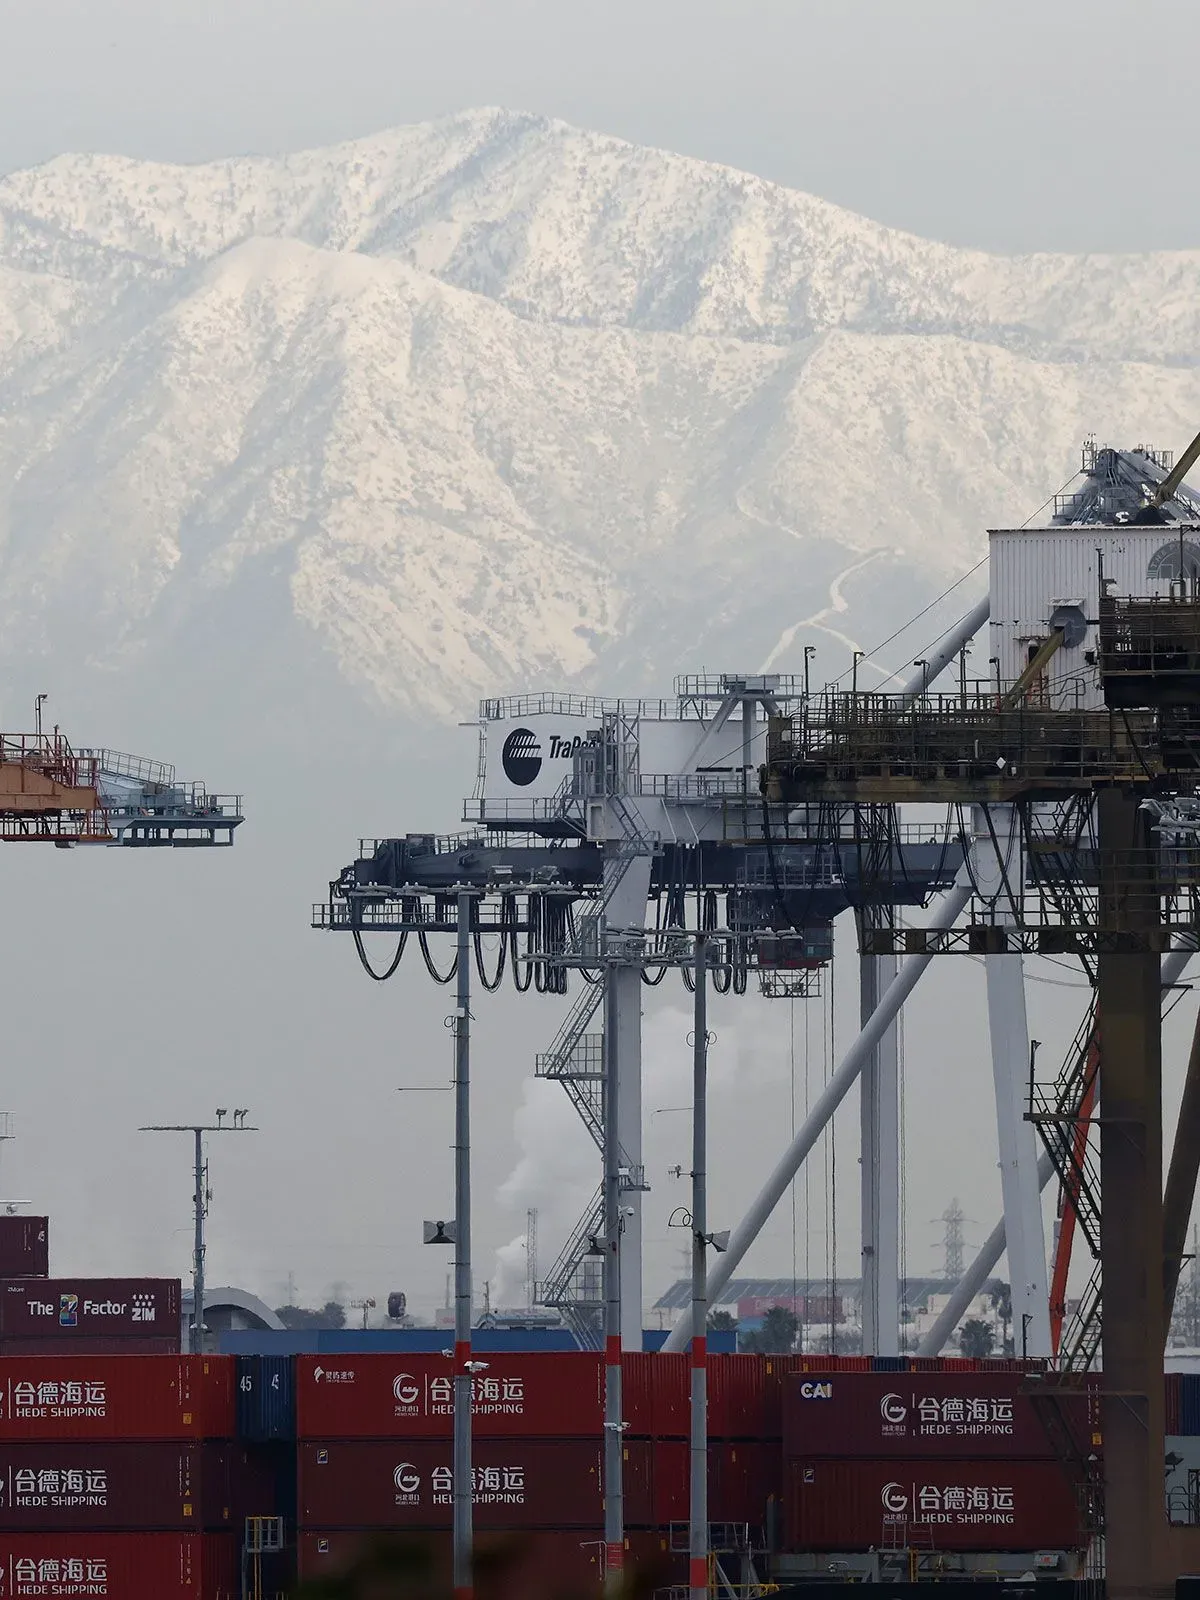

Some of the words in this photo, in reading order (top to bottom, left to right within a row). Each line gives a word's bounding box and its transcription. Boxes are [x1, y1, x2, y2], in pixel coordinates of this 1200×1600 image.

[549, 735, 596, 758] TraP
[27, 1301, 54, 1316] The
[84, 1300, 127, 1315] Factor
[132, 1307, 156, 1321] ZIM
[240, 1375, 252, 1392] 45
[800, 1383, 832, 1398] CAI
[14, 1381, 106, 1405] 台德海运
[16, 1407, 47, 1417] HEDE
[50, 1407, 105, 1417] SHIPPING
[471, 1404, 523, 1414] SHIPPING
[917, 1397, 1013, 1422] 台德海运
[920, 1425, 951, 1435] HEDE
[956, 1425, 1013, 1435] SHIPPING
[15, 1469, 107, 1493] 台德海运
[17, 1496, 47, 1506] HEDE
[51, 1496, 107, 1506] SHIPPING
[918, 1486, 1014, 1510] 台德海运
[921, 1514, 952, 1524] HEDE
[957, 1514, 1014, 1524] SHIPPING
[16, 1558, 107, 1582] 台德海运
[17, 1585, 48, 1595] HEDE
[51, 1585, 107, 1595] SHIPPING
